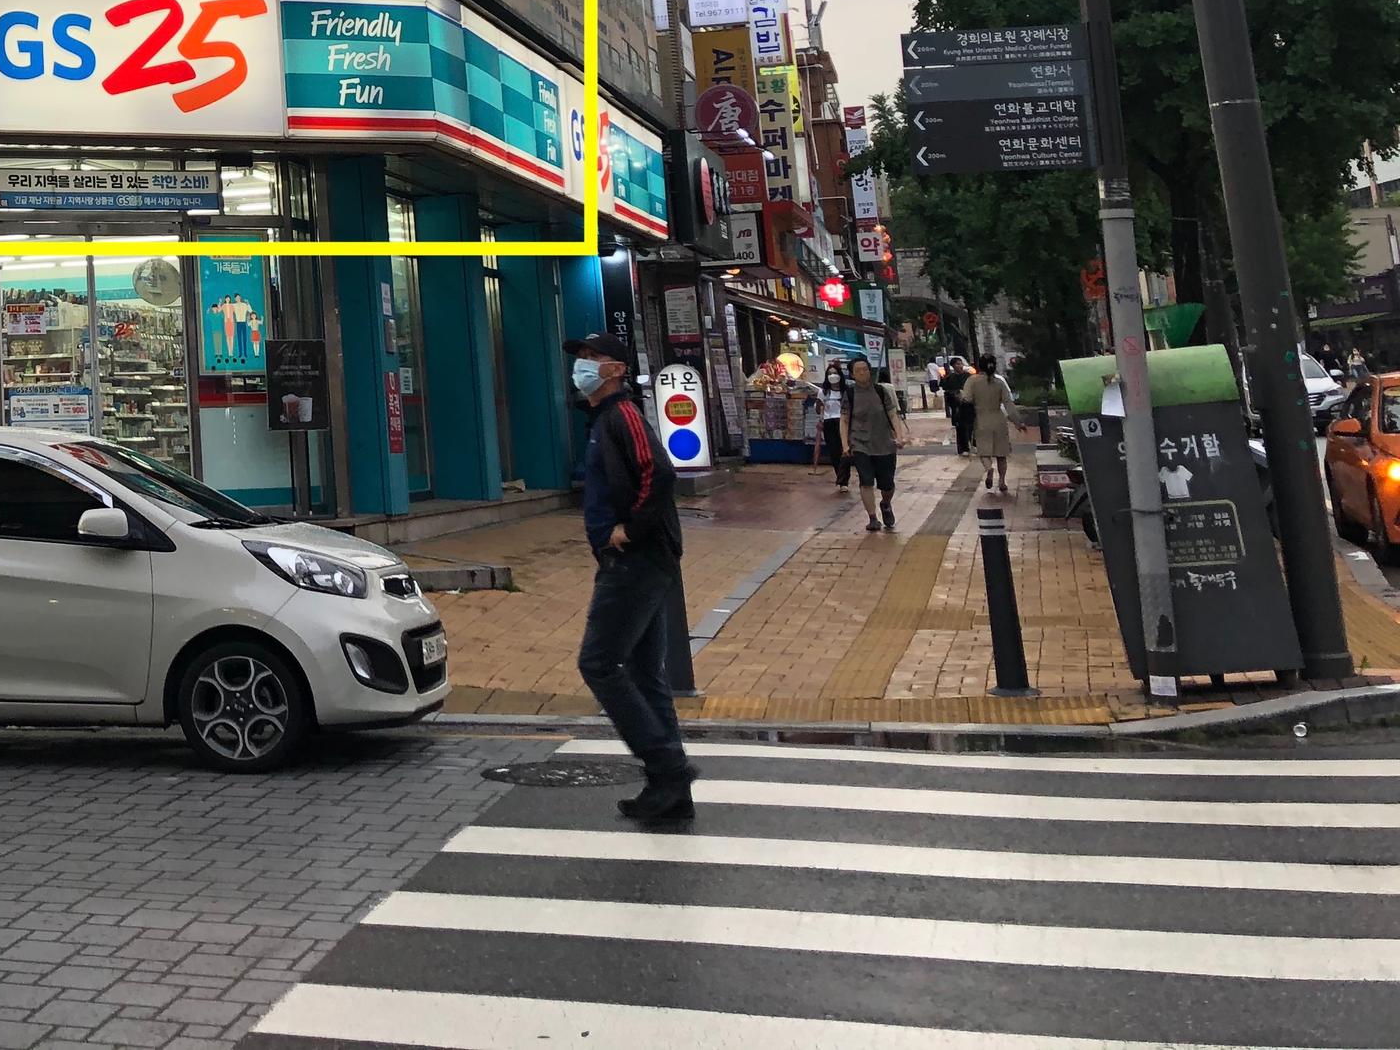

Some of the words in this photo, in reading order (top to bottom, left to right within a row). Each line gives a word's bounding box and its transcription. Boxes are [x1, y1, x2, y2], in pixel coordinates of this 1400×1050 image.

[310, 10, 403, 45] Friendly
[957, 30, 1016, 46] 경희의료원
[1020, 28, 1070, 43] 장례식장
[326, 45, 392, 73] Fresh
[1030, 65, 1072, 78] 연화사
[338, 80, 384, 106] Fun
[994, 99, 1077, 116] 연화불교대학
[999, 135, 1081, 152] 연화문화센터
[8, 174, 31, 188] 우리
[35, 174, 70, 189] 지역을
[73, 175, 107, 189] 살리는
[111, 174, 123, 189] 힘
[126, 175, 149, 189] 있는
[151, 175, 178, 189] 착한
[180, 175, 209, 189] 소비!
[860, 237, 881, 256] 약
[1160, 433, 1220, 460] 수거함
